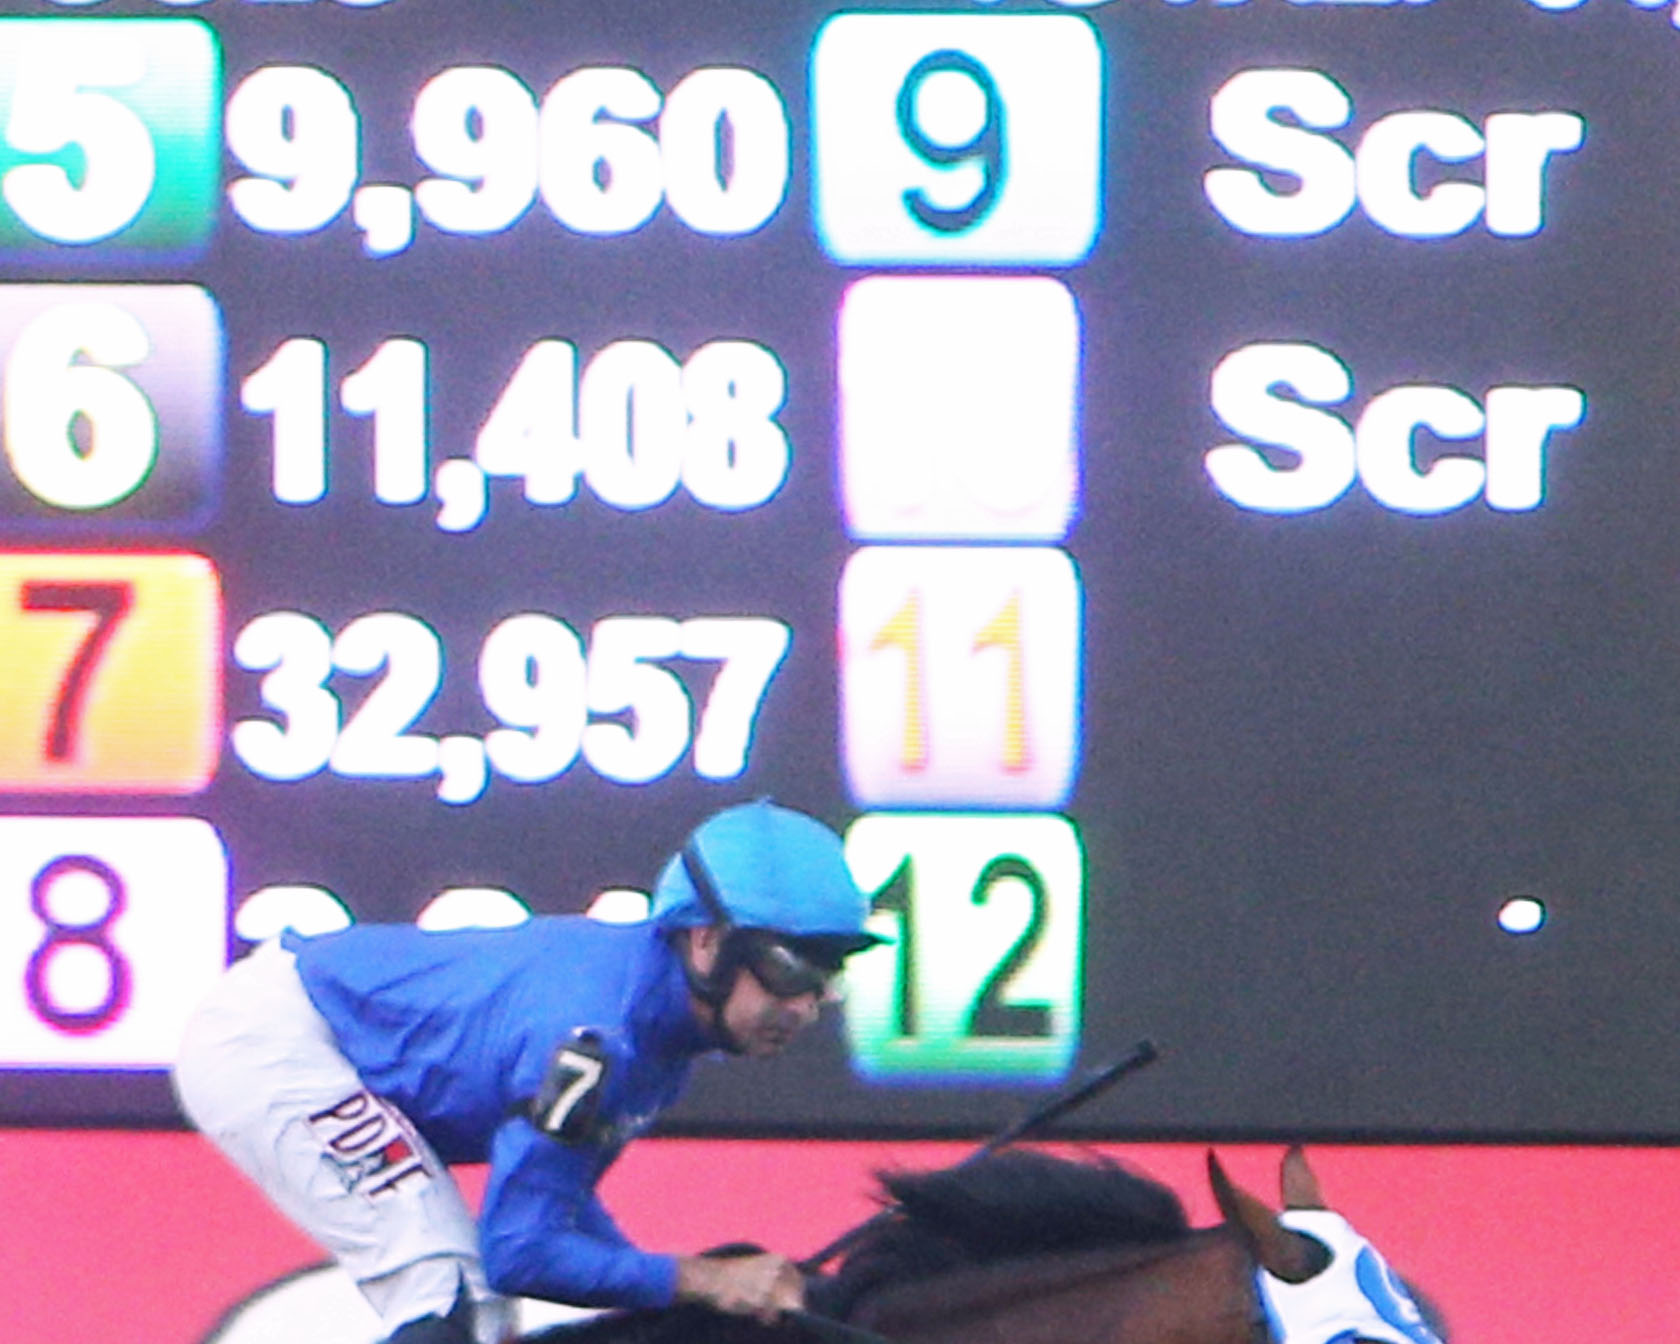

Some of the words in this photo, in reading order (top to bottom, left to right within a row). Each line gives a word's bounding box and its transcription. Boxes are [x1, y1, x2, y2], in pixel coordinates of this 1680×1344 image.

[0, 32, 156, 246] 5
[224, 65, 792, 257] 9,960
[893, 48, 1010, 236] 9
[1203, 66, 1586, 238] Scr
[2, 300, 160, 510] 6
[240, 337, 792, 533] 11,408
[1203, 342, 1586, 515] Scr
[16, 580, 136, 768] 7
[231, 612, 793, 805] 32,957
[868, 590, 1034, 775] 11
[24, 854, 132, 1036] 8
[868, 852, 1054, 1038] 12
[544, 1048, 603, 1132] 7
